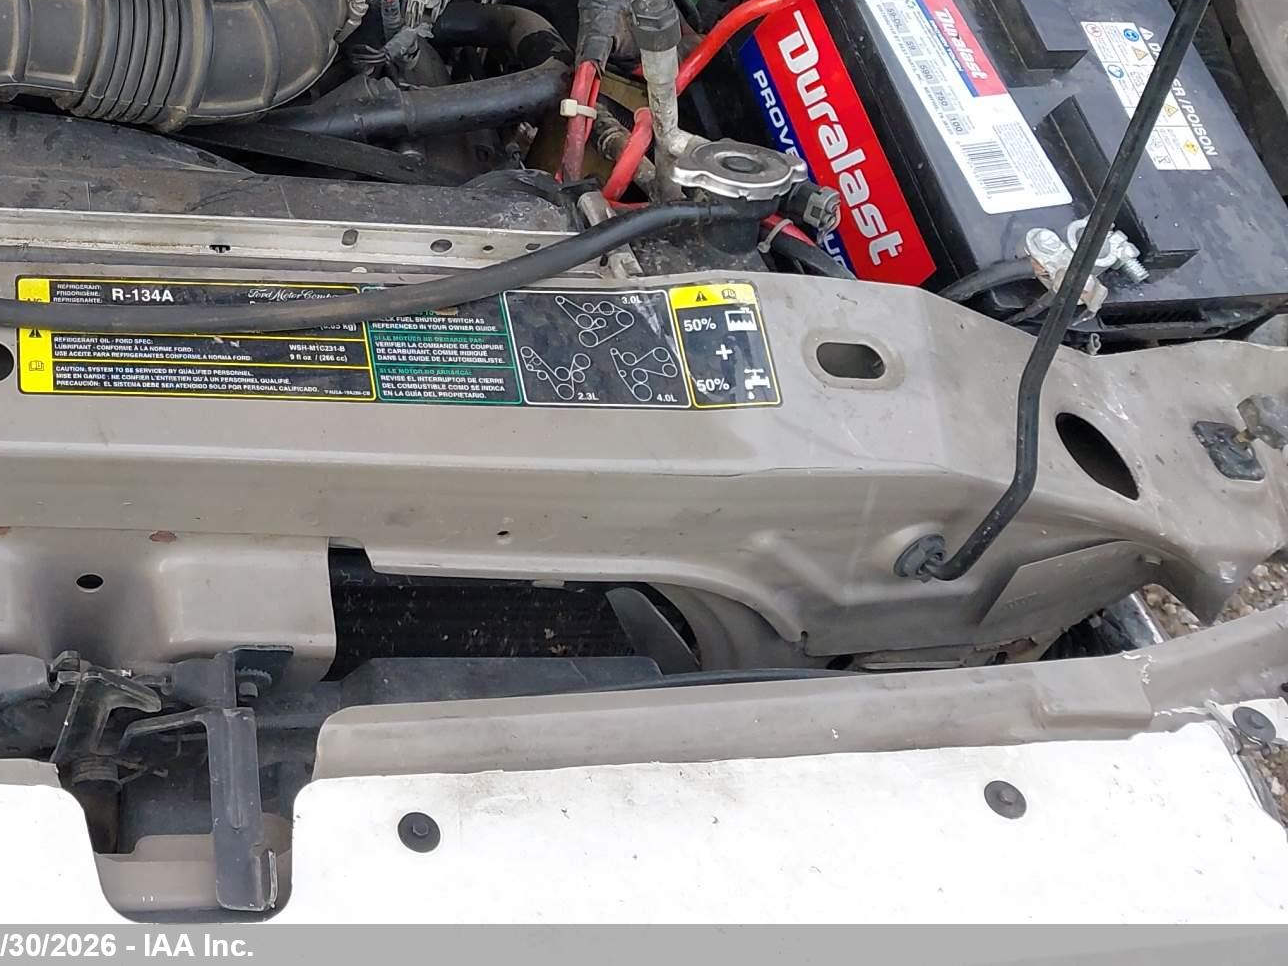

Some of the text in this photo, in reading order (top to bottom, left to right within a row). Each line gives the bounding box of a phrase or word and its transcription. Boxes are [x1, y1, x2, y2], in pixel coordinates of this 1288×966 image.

[906, 40, 917, 51] 59
[935, 7, 988, 80] Duralast
[919, 64, 933, 80] 590
[935, 90, 948, 107] 750
[950, 117, 963, 132] 100
[1182, 105, 1219, 156] POISON
[778, 9, 904, 266] Duralast
[112, 288, 174, 302] R-134A
[622, 296, 642, 305] 3.0L
[372, 322, 418, 330] REFERENCED
[683, 317, 716, 332] 50%
[151, 374, 192, 382] L'ENTRETIEN
[213, 369, 254, 377] PERSONNEL.
[278, 385, 320, 393] CALIFICADO.
[397, 382, 447, 390] COMBUSTIBLE
[696, 377, 730, 393] 50%
[438, 391, 487, 399] PROPIETARIO.
[577, 392, 599, 401] 2.3L
[656, 394, 677, 403] 4.0L
